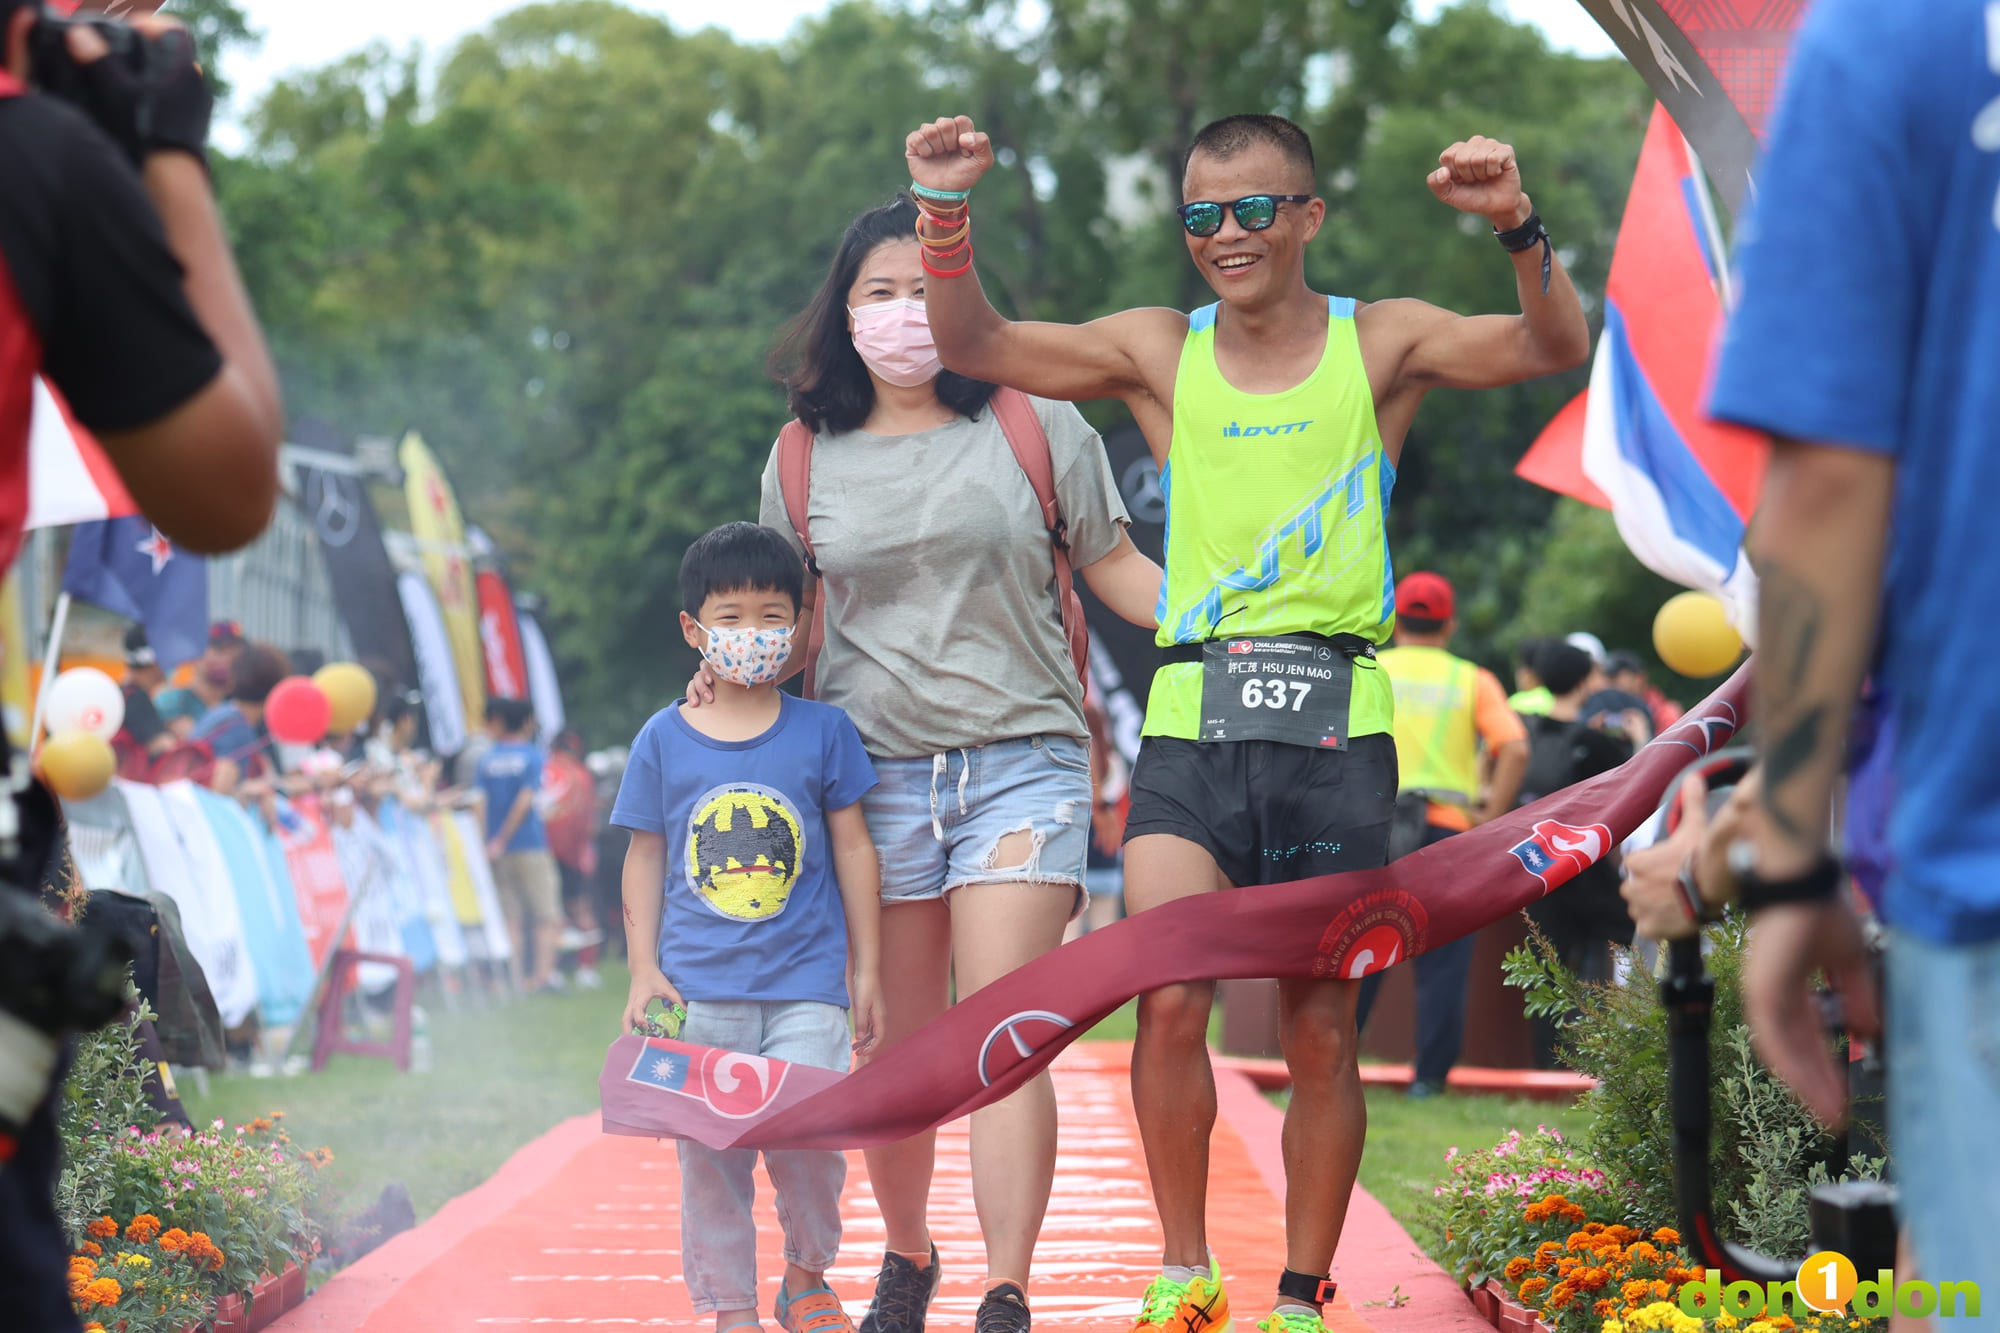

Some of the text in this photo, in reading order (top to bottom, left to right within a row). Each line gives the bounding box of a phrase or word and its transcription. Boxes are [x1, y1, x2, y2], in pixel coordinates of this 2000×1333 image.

[1262, 662, 1332, 679] HSU JEN MAO
[1241, 678, 1312, 712] 637
[1350, 911, 1383, 936] TAIWAN
